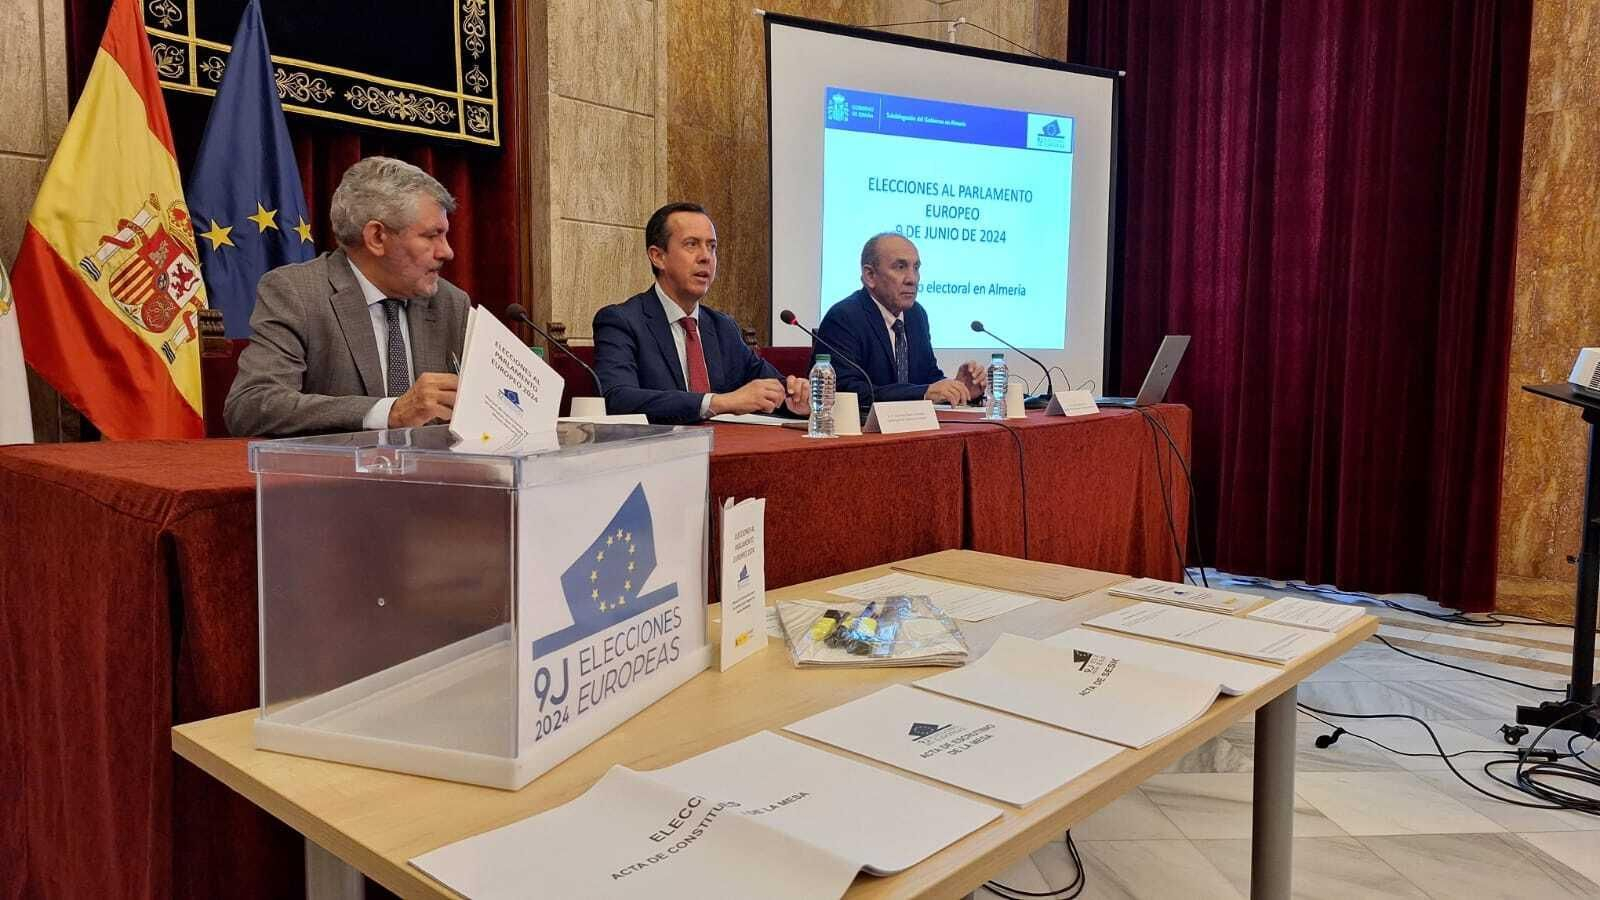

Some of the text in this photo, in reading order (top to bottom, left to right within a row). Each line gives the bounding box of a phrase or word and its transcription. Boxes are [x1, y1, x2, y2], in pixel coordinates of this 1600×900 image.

[868, 177, 1033, 203] ELECCIONES AL PARLAMENTO
[925, 204, 980, 221] EUROPEO
[906, 225, 921, 239] DE
[924, 226, 959, 241] JUNIO
[962, 228, 977, 242] DE
[979, 229, 1007, 243] 2024
[926, 280, 970, 295] electoral
[973, 284, 986, 295] en
[579, 606, 683, 677] ELECCIONES
[533, 657, 570, 713] 9J
[577, 636, 680, 716] EUROPEAS
[535, 705, 570, 742] 2024
[611, 862, 648, 881] ACTA
[647, 852, 668, 864] DE
[777, 792, 810, 806] MESA
